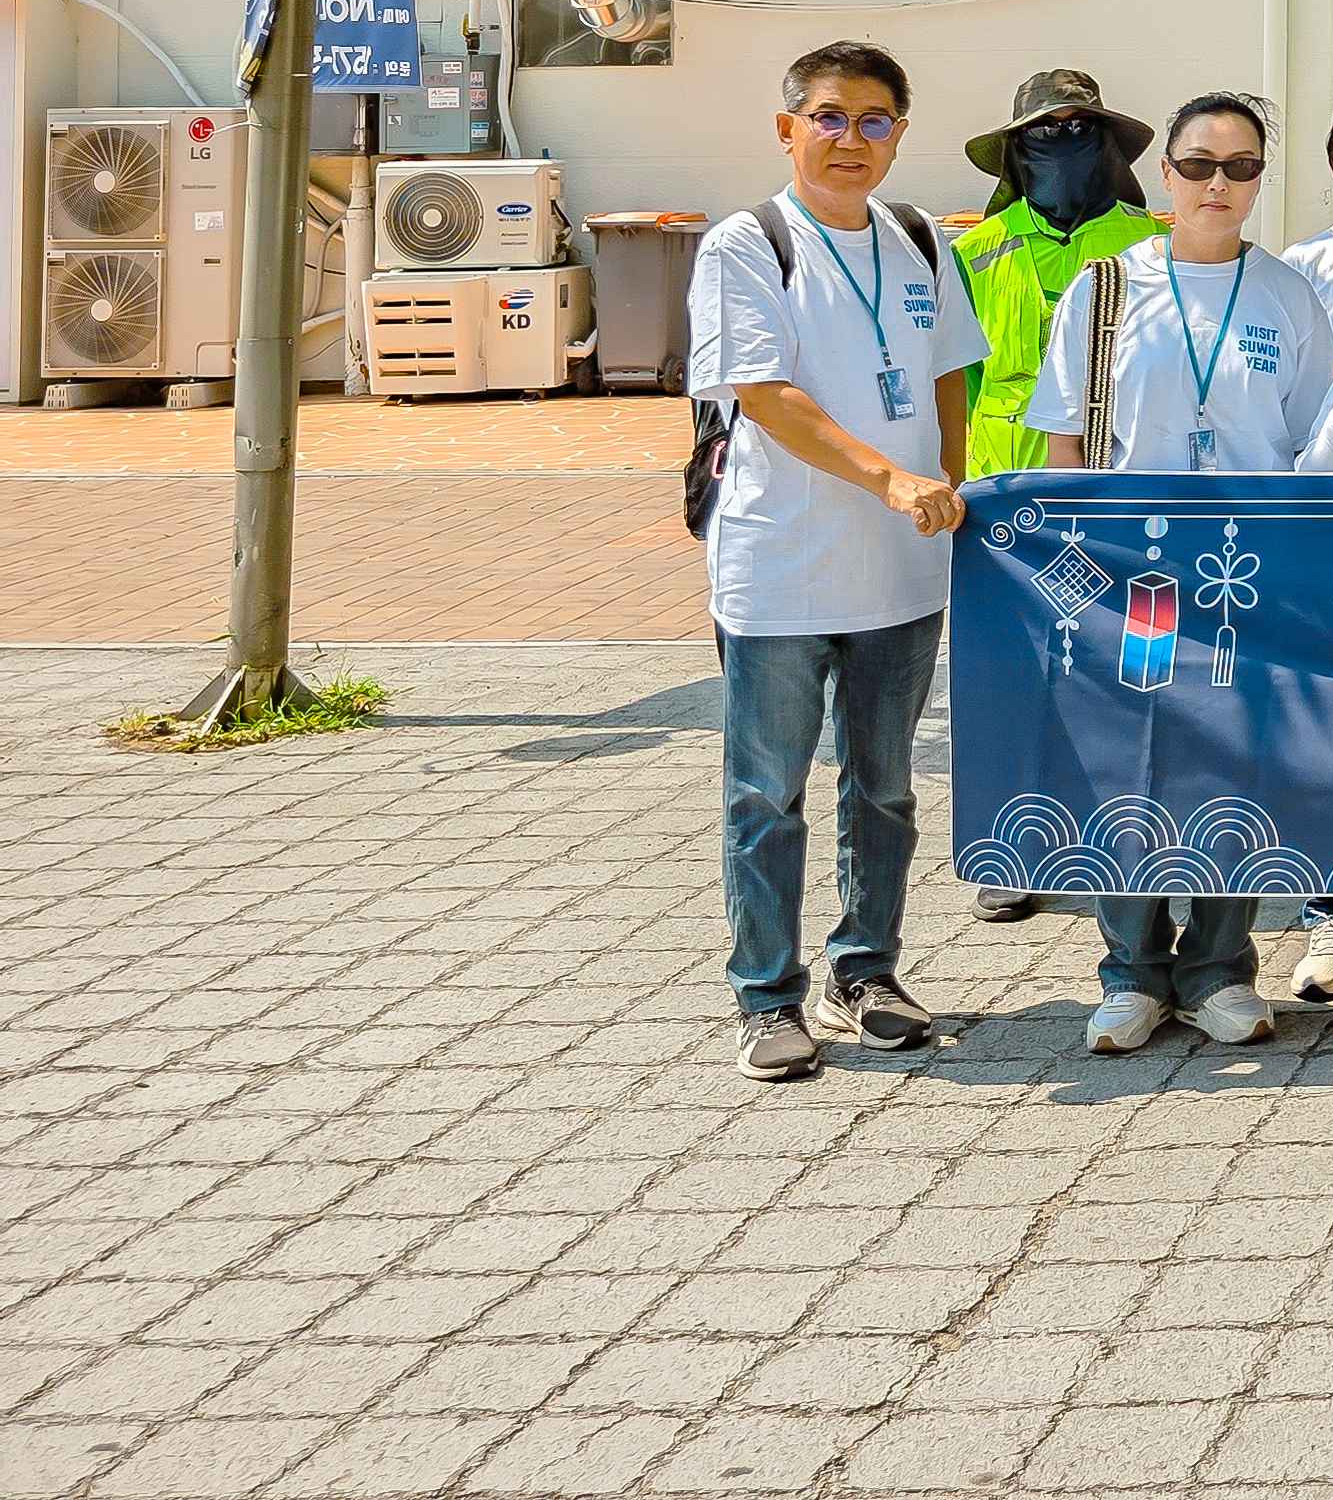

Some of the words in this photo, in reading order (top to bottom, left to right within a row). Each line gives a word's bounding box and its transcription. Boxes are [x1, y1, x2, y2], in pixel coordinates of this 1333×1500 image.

[190, 146, 212, 160] LG
[903, 283, 929, 297] VISIT
[501, 313, 532, 331] KD
[1245, 325, 1279, 342] VISIT
[1245, 356, 1277, 375] YEAR
